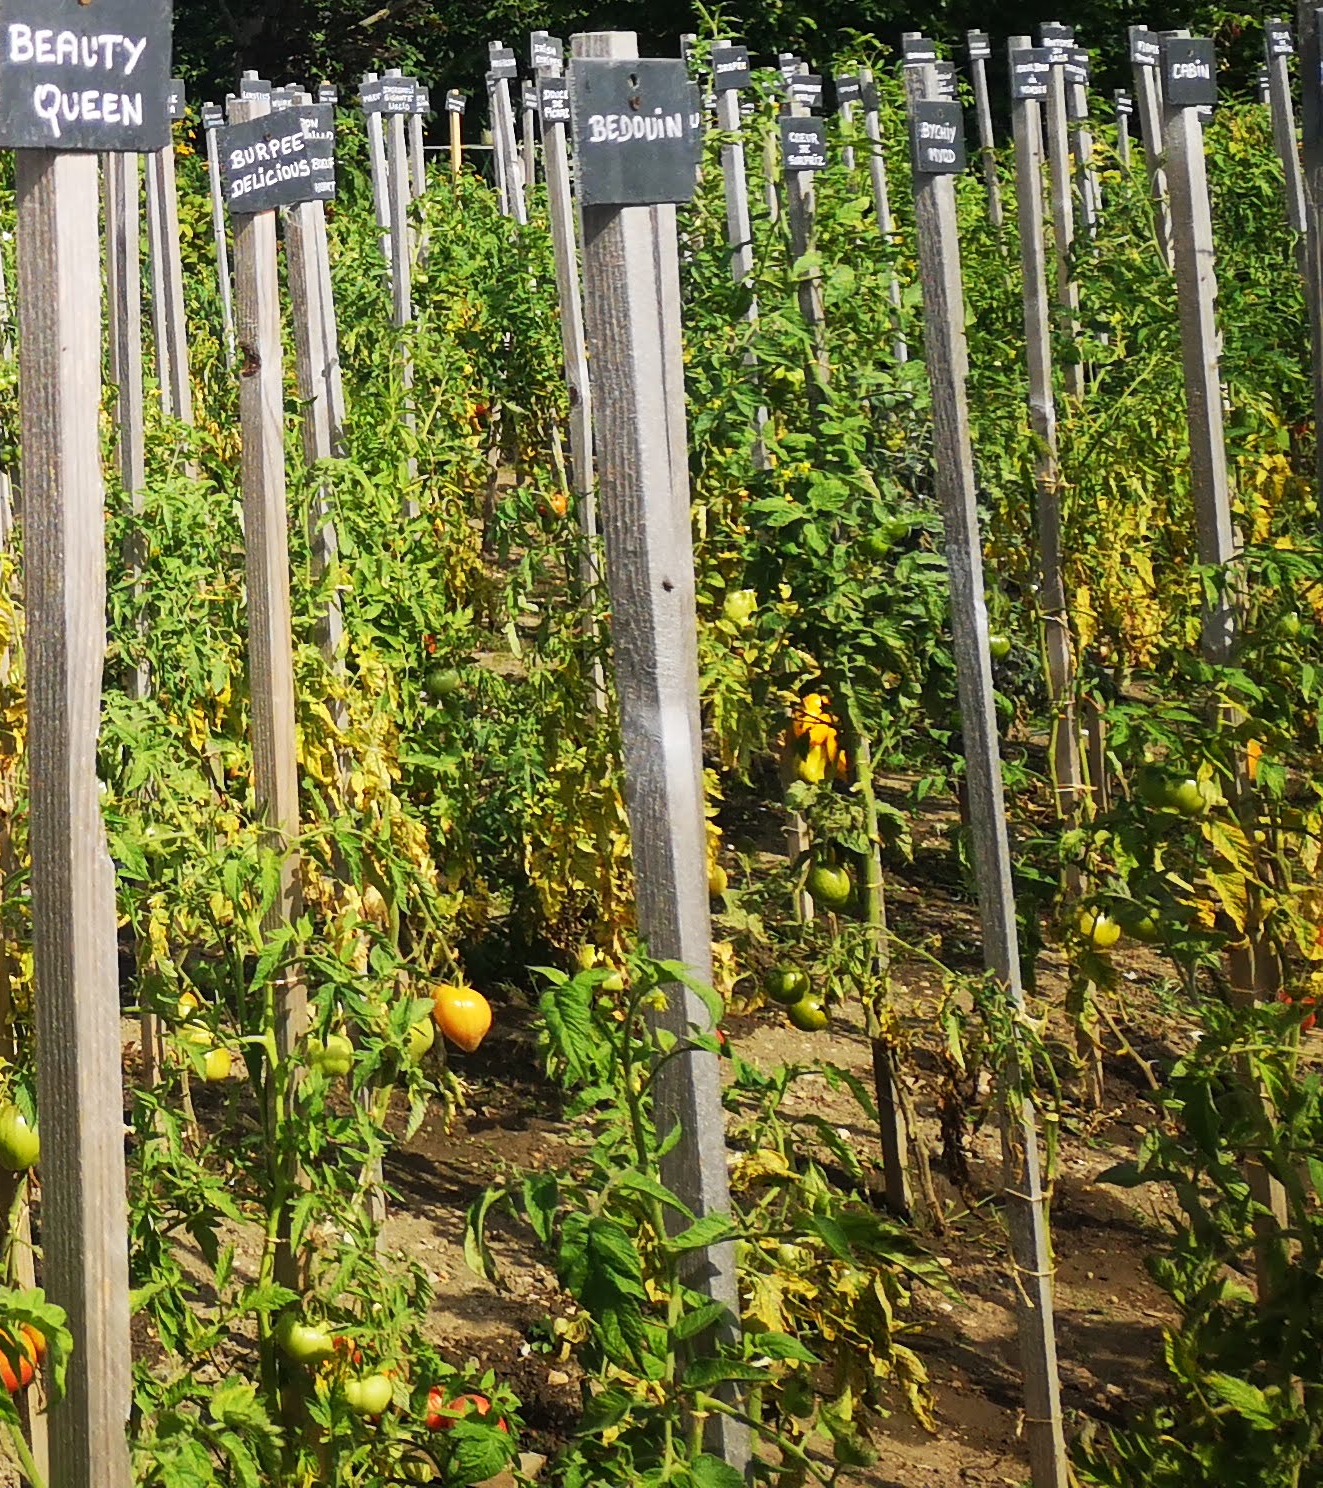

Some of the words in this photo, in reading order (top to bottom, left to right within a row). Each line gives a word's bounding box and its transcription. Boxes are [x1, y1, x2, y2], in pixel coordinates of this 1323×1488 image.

[8, 24, 148, 75] BEAUTY
[33, 85, 143, 137] QUEEN
[230, 132, 305, 170] BURPEE
